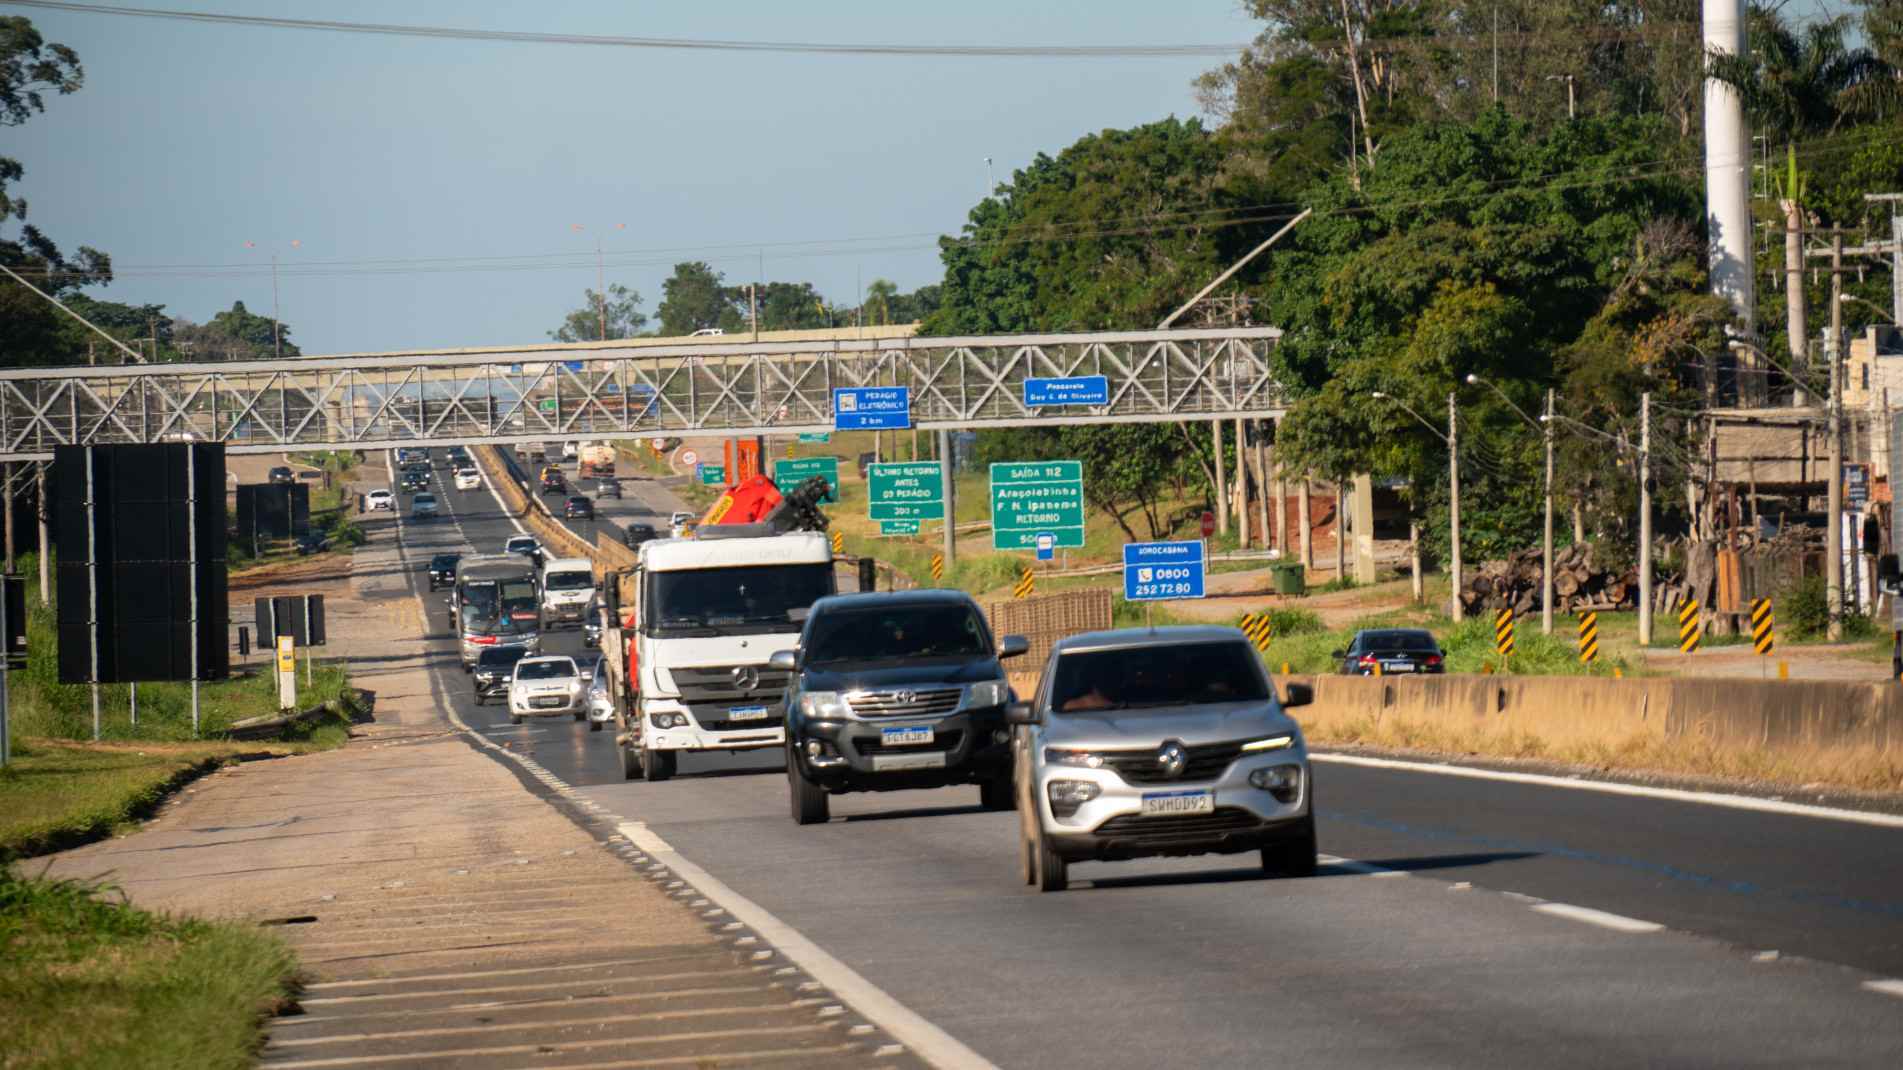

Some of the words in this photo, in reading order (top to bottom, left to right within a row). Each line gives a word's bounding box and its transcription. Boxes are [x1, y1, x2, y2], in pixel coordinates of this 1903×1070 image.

[1010, 467, 1040, 479] SAÍDA
[1156, 568, 1190, 580] 0800
[1135, 584, 1158, 596] 252
[1159, 582, 1191, 594] 7280
